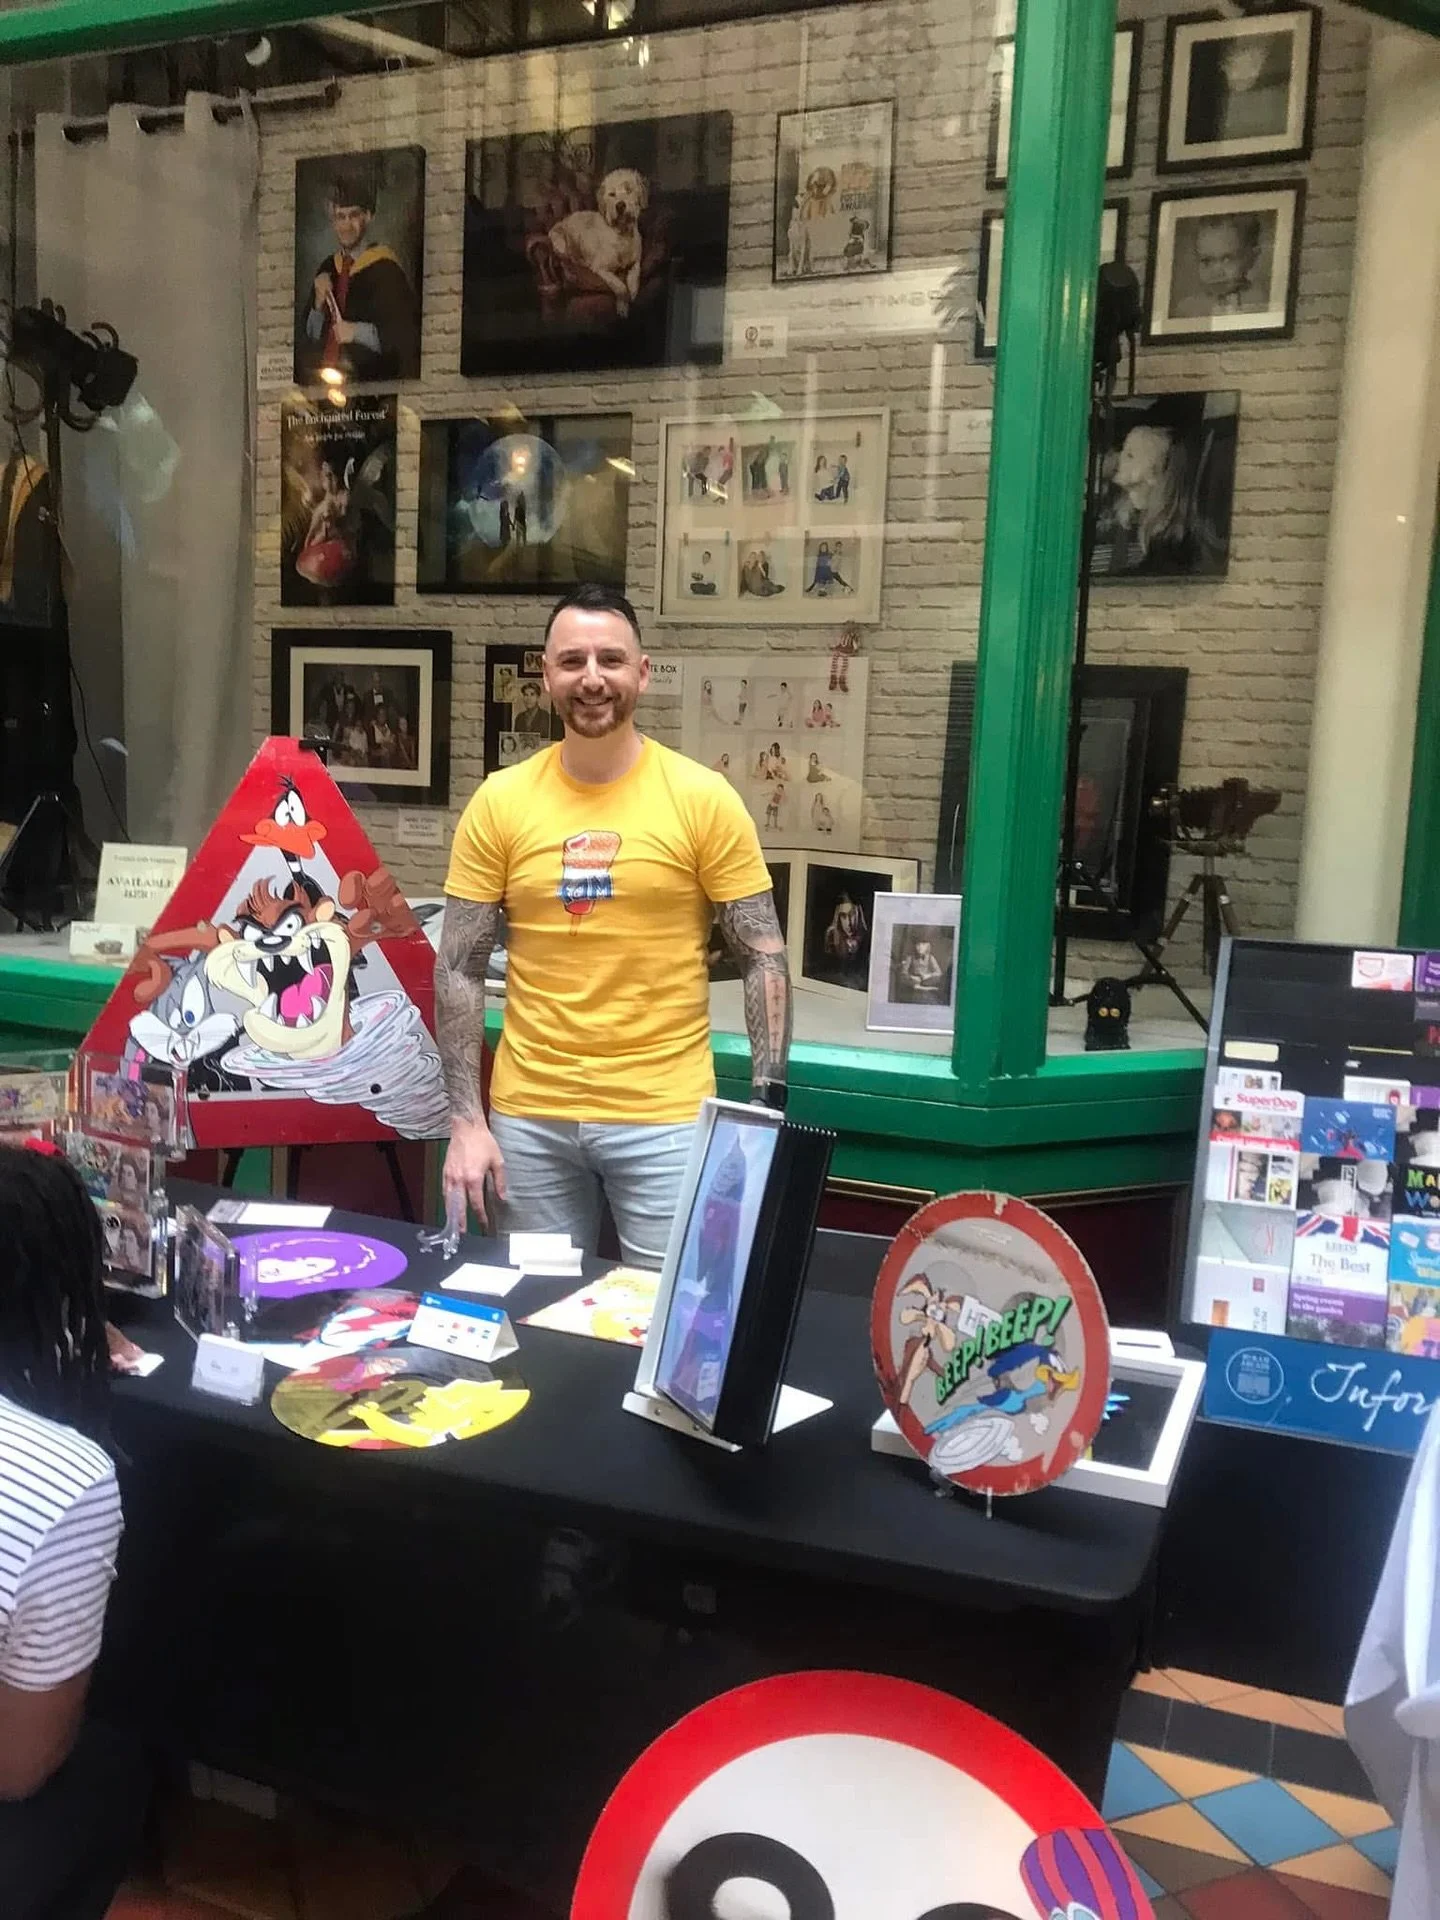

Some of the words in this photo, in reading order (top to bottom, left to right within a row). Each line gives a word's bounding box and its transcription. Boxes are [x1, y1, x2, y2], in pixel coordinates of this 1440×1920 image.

[286, 414, 303, 429] The
[660, 664, 677, 673] BOX
[1236, 1093, 1298, 1111] SuperDog
[1310, 1253, 1336, 1269] The
[1340, 1258, 1371, 1274] Best
[982, 1295, 1073, 1356] BEEP!
[934, 1323, 985, 1405] BEEP!
[1310, 1361, 1436, 1432] Infor
